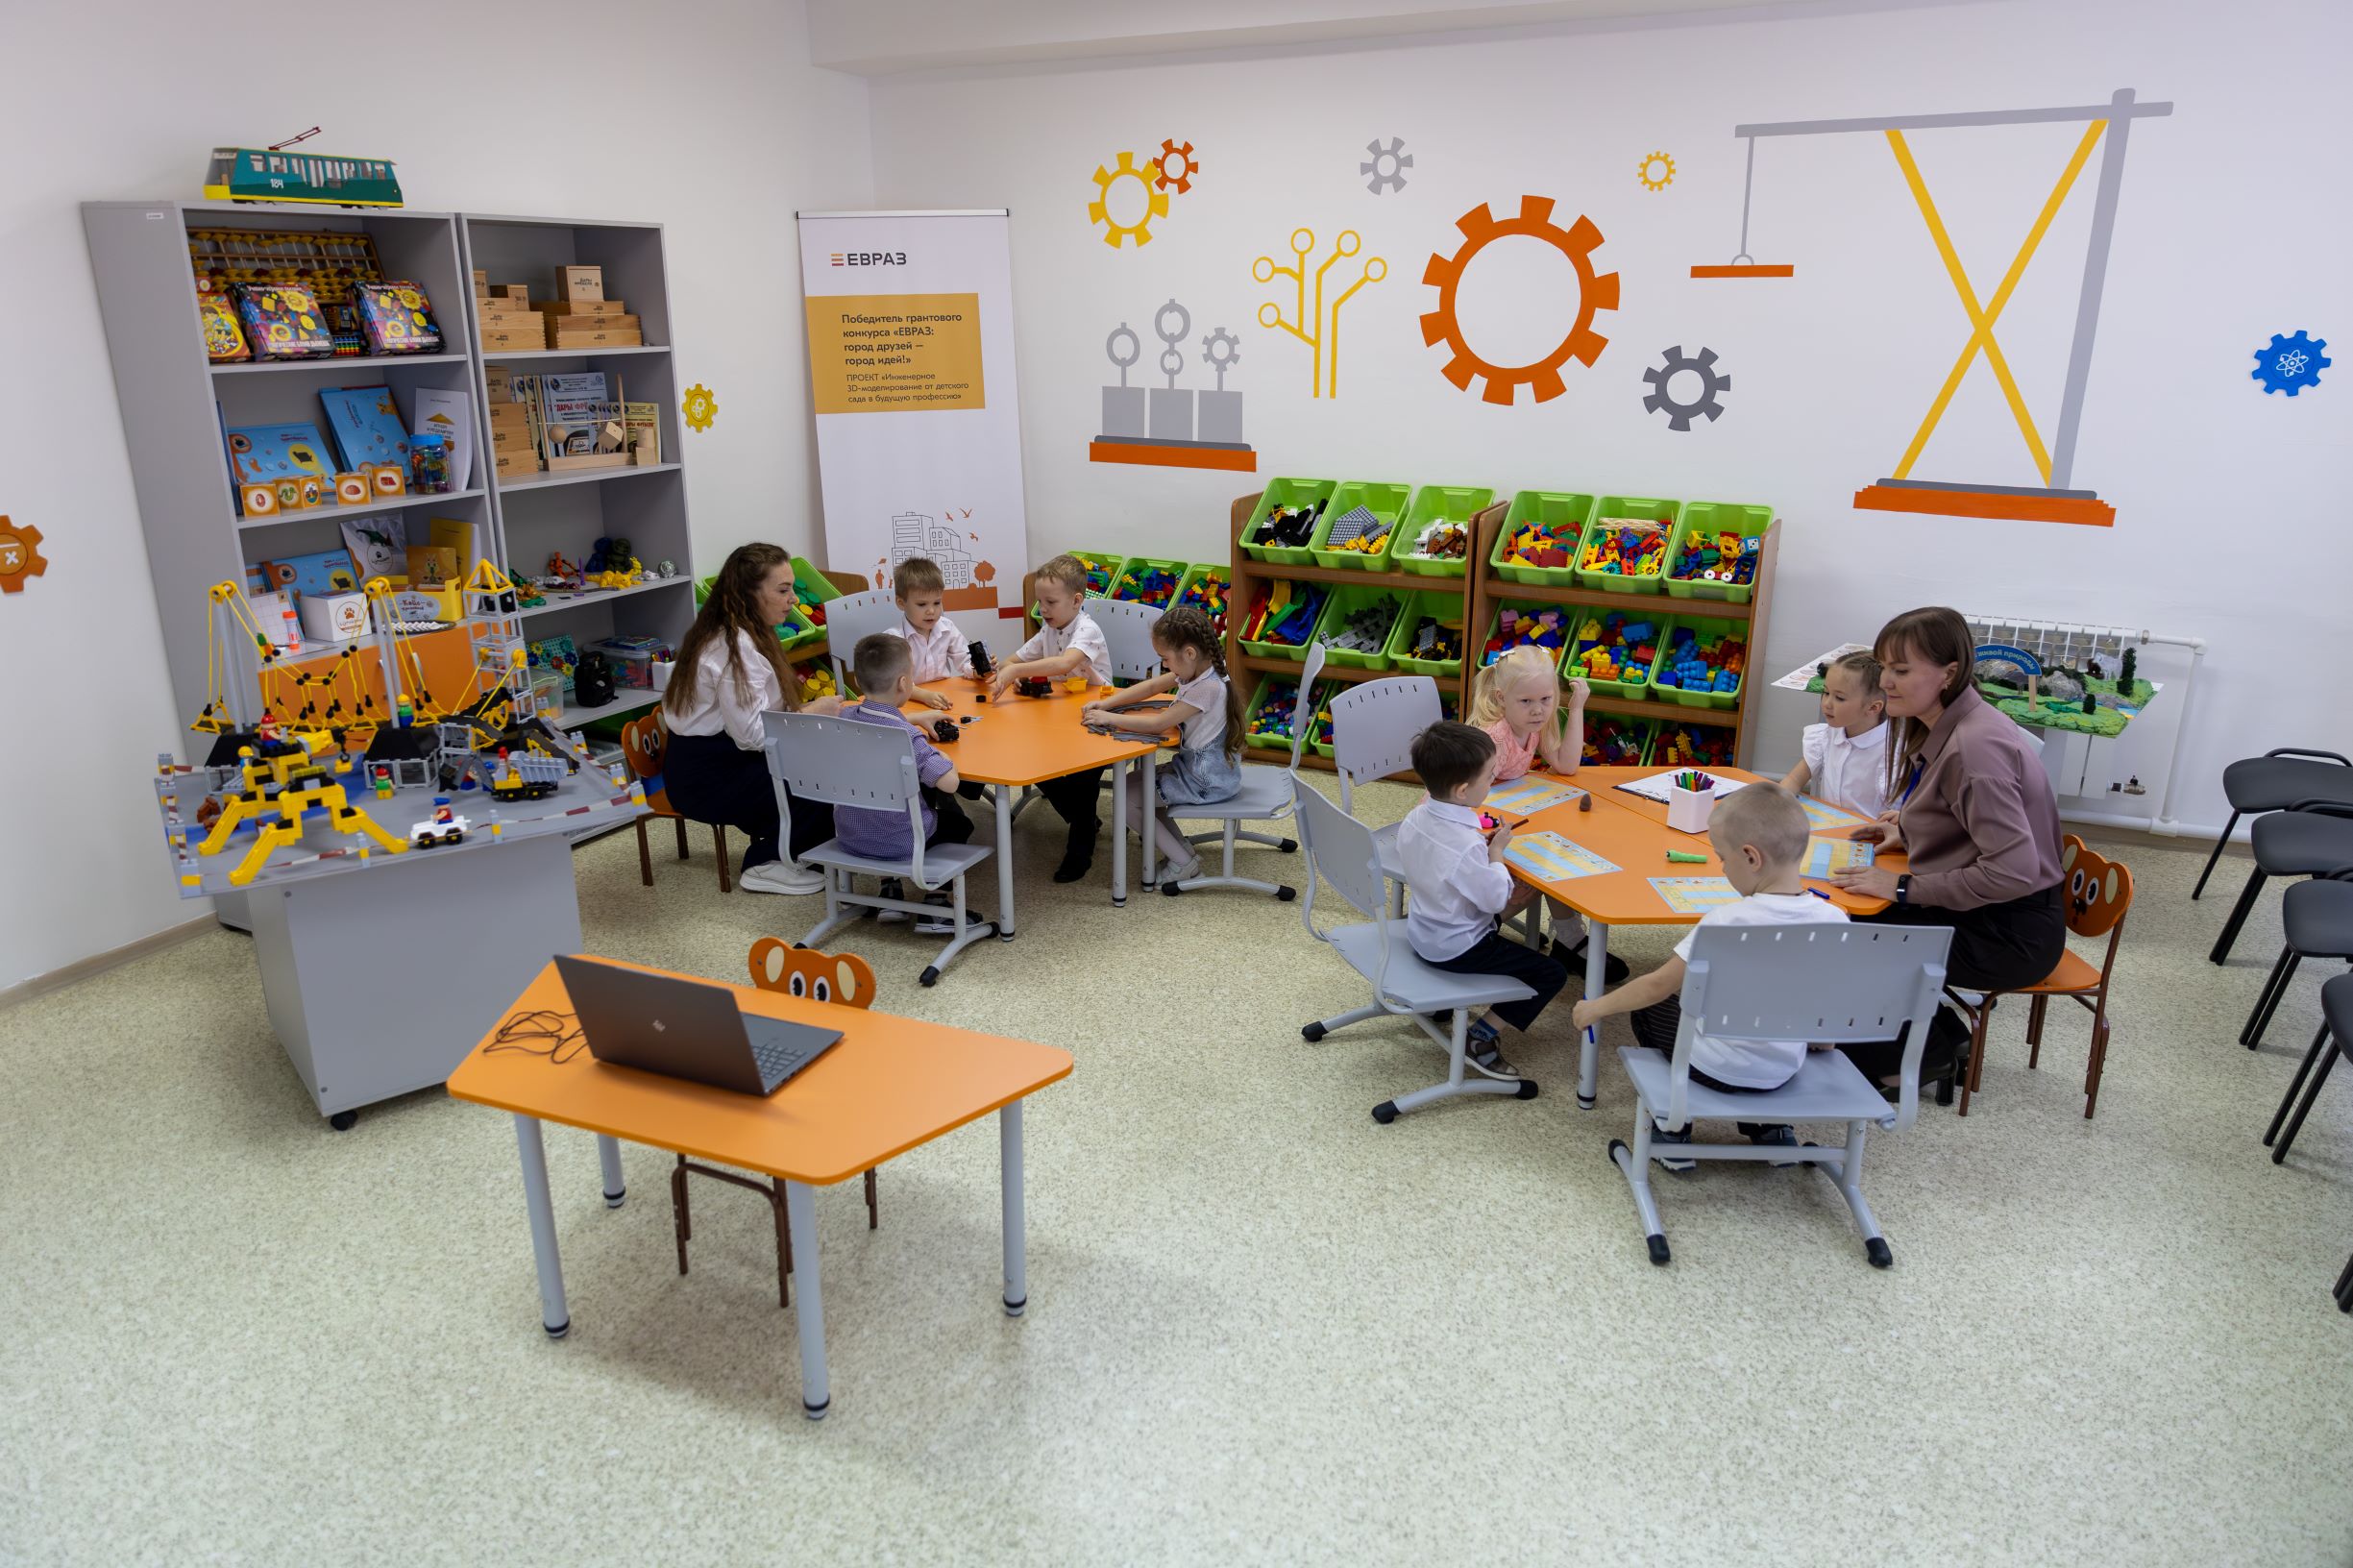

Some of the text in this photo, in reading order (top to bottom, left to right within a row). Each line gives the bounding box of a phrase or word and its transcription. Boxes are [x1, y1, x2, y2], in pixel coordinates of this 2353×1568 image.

[270, 178, 284, 189] 184
[847, 252, 907, 266] ЕВРАЗ
[842, 314, 962, 324] Победитель грантового
[843, 327, 935, 339] конкурса «ЕВРАЗ:
[845, 343, 874, 352] город
[876, 342, 913, 352] друзей
[846, 355, 912, 367] город идей!»
[846, 383, 922, 393] 3D-моделирование
[875, 394, 911, 403] будущую
[912, 393, 962, 402] профессию»
[1977, 649, 2035, 670] живой природы
